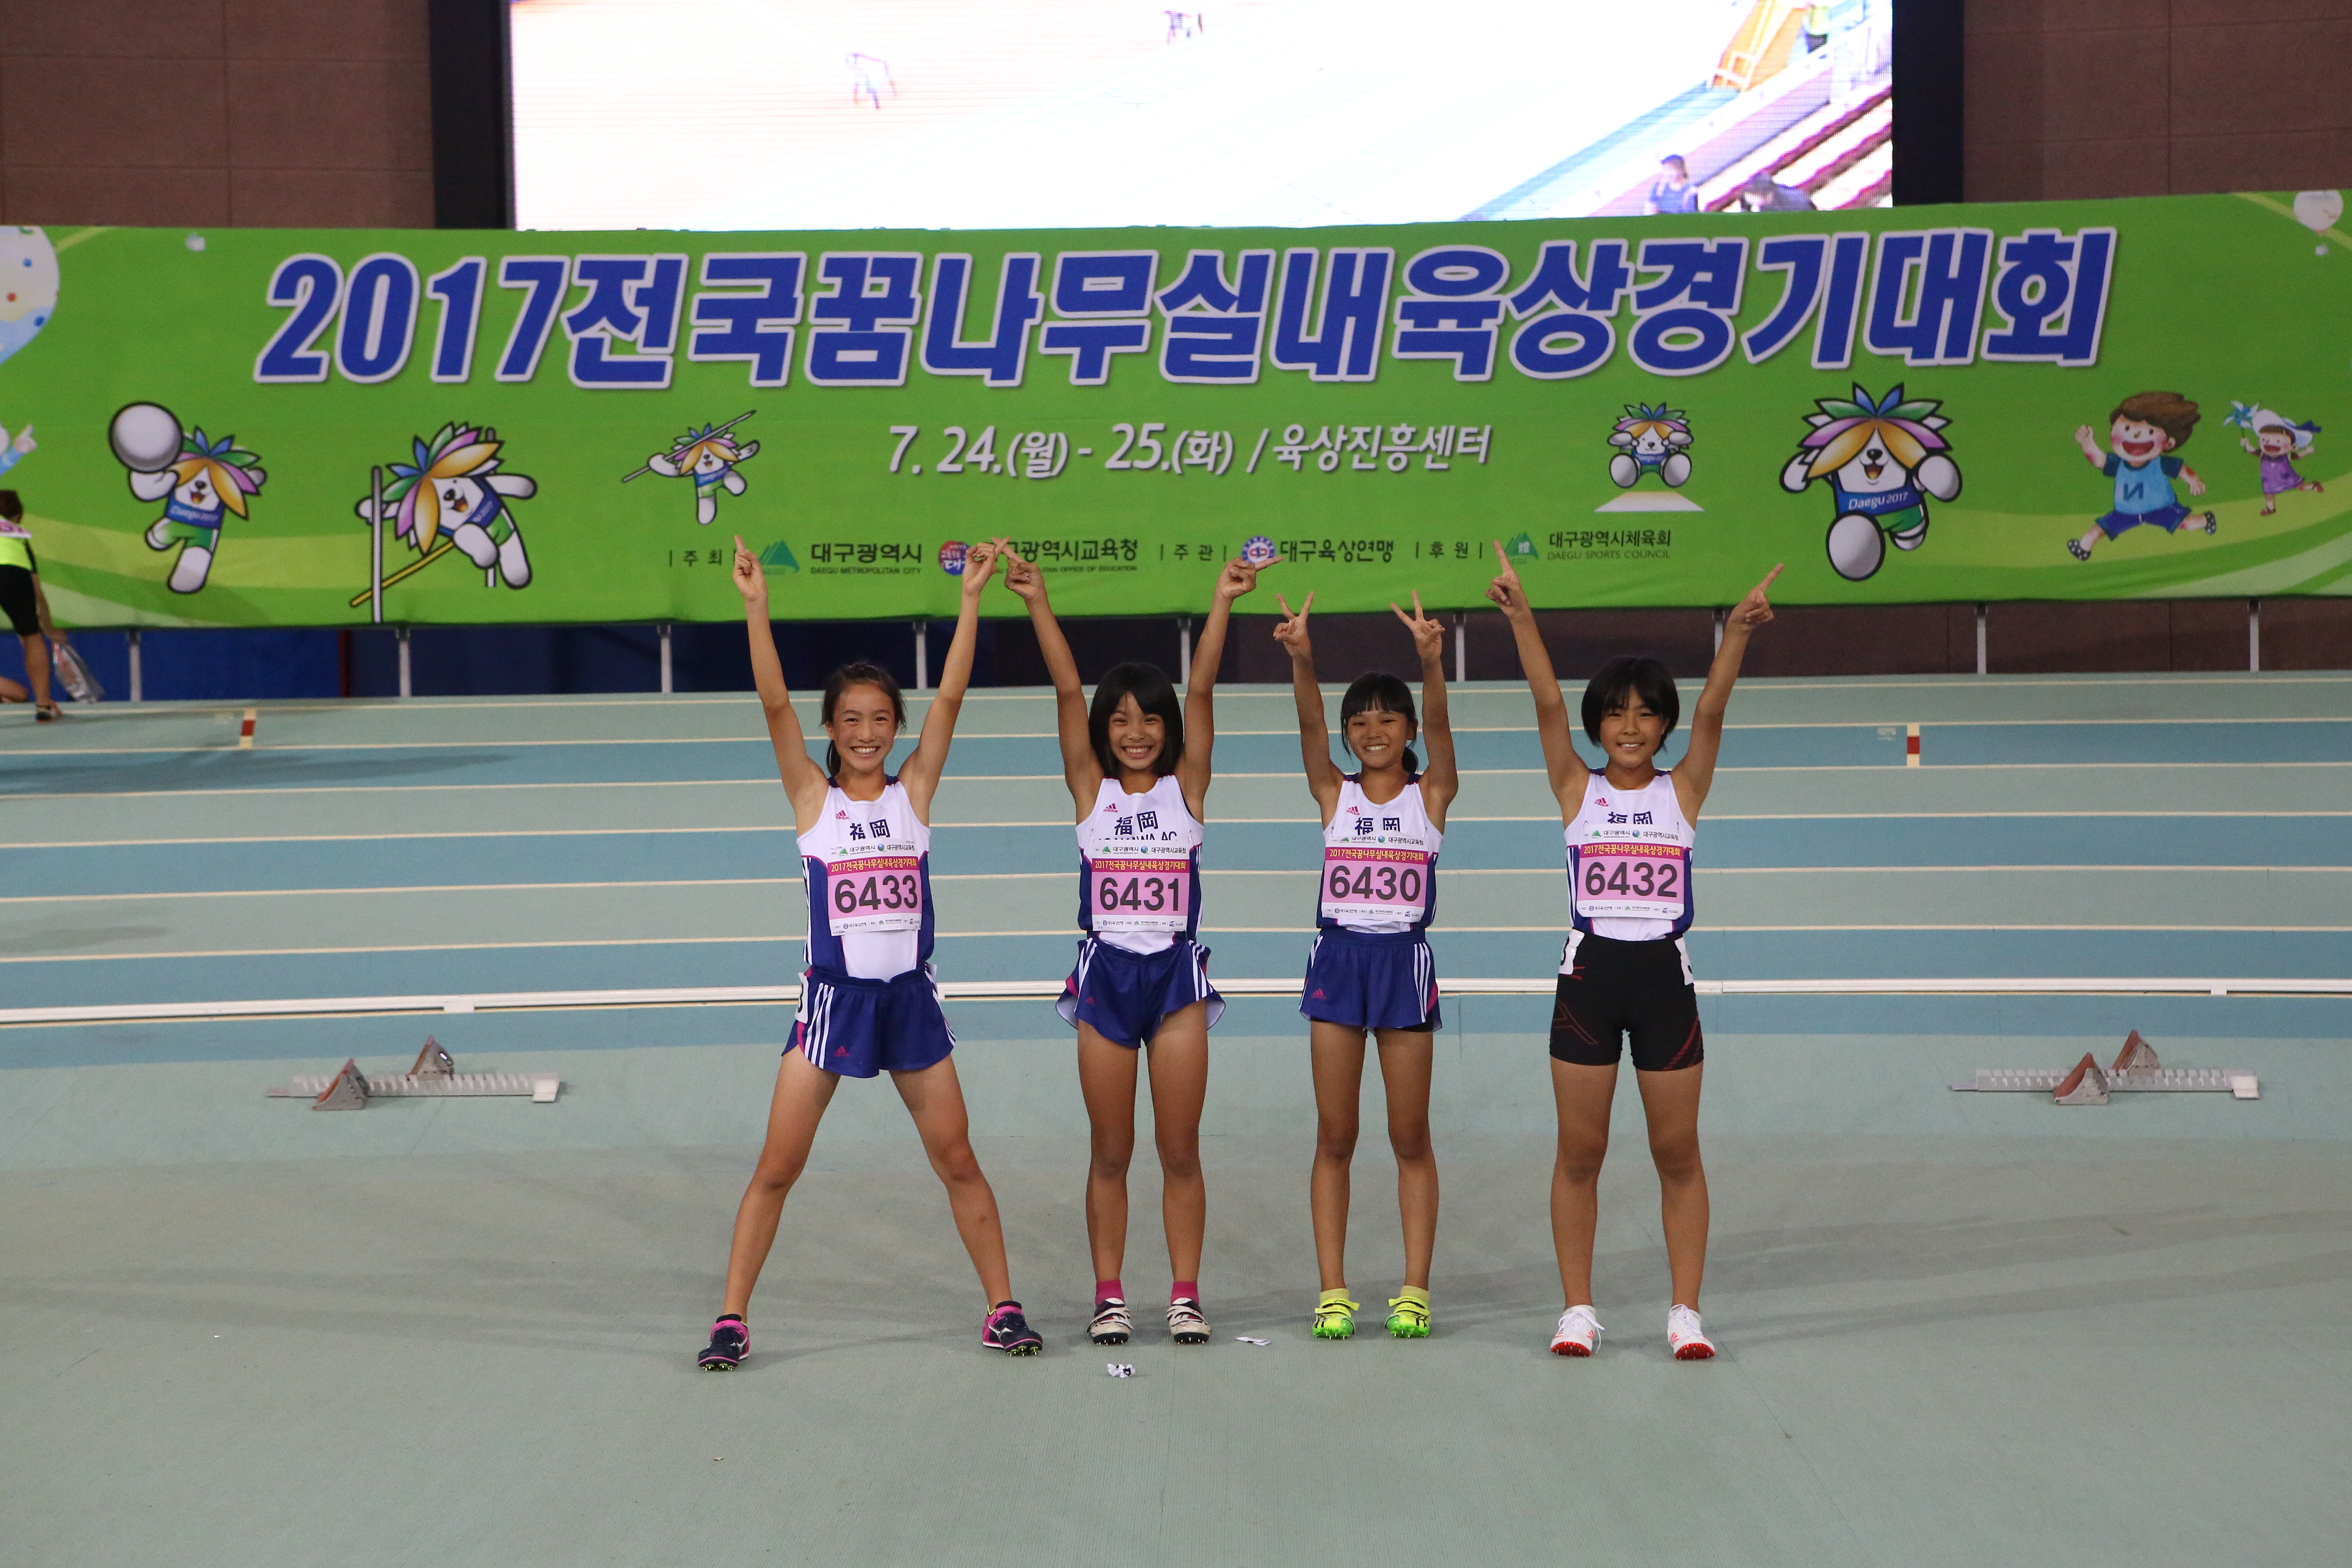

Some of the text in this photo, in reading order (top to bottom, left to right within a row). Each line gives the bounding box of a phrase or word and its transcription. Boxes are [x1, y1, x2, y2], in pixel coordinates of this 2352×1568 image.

[253, 227, 2118, 390] 2017전국꿈나무실내육상경기대회
[985, 538, 1138, 563] 광역시교육청
[1280, 539, 1394, 562] 대구육상연맹
[1550, 530, 1670, 548] 대구광역시체육회
[811, 543, 922, 563] 대구광역시
[1114, 811, 1158, 835] 福岡
[1389, 837, 1423, 845] 대구광역시교육청
[1584, 844, 1680, 856] 2017전국꿈나무실내육상경기대회
[831, 858, 917, 872] 2017전국꿈나무실내육상경기대회
[1095, 860, 1186, 870] 2017전국꿈나무실내육상경기대회
[1330, 849, 1423, 861] 2017전국꿈나무실내육상경기대회
[1330, 865, 1420, 901] 6430
[1586, 862, 1677, 898] 6432
[835, 875, 918, 913] 6433
[1100, 878, 1178, 911] 6431
